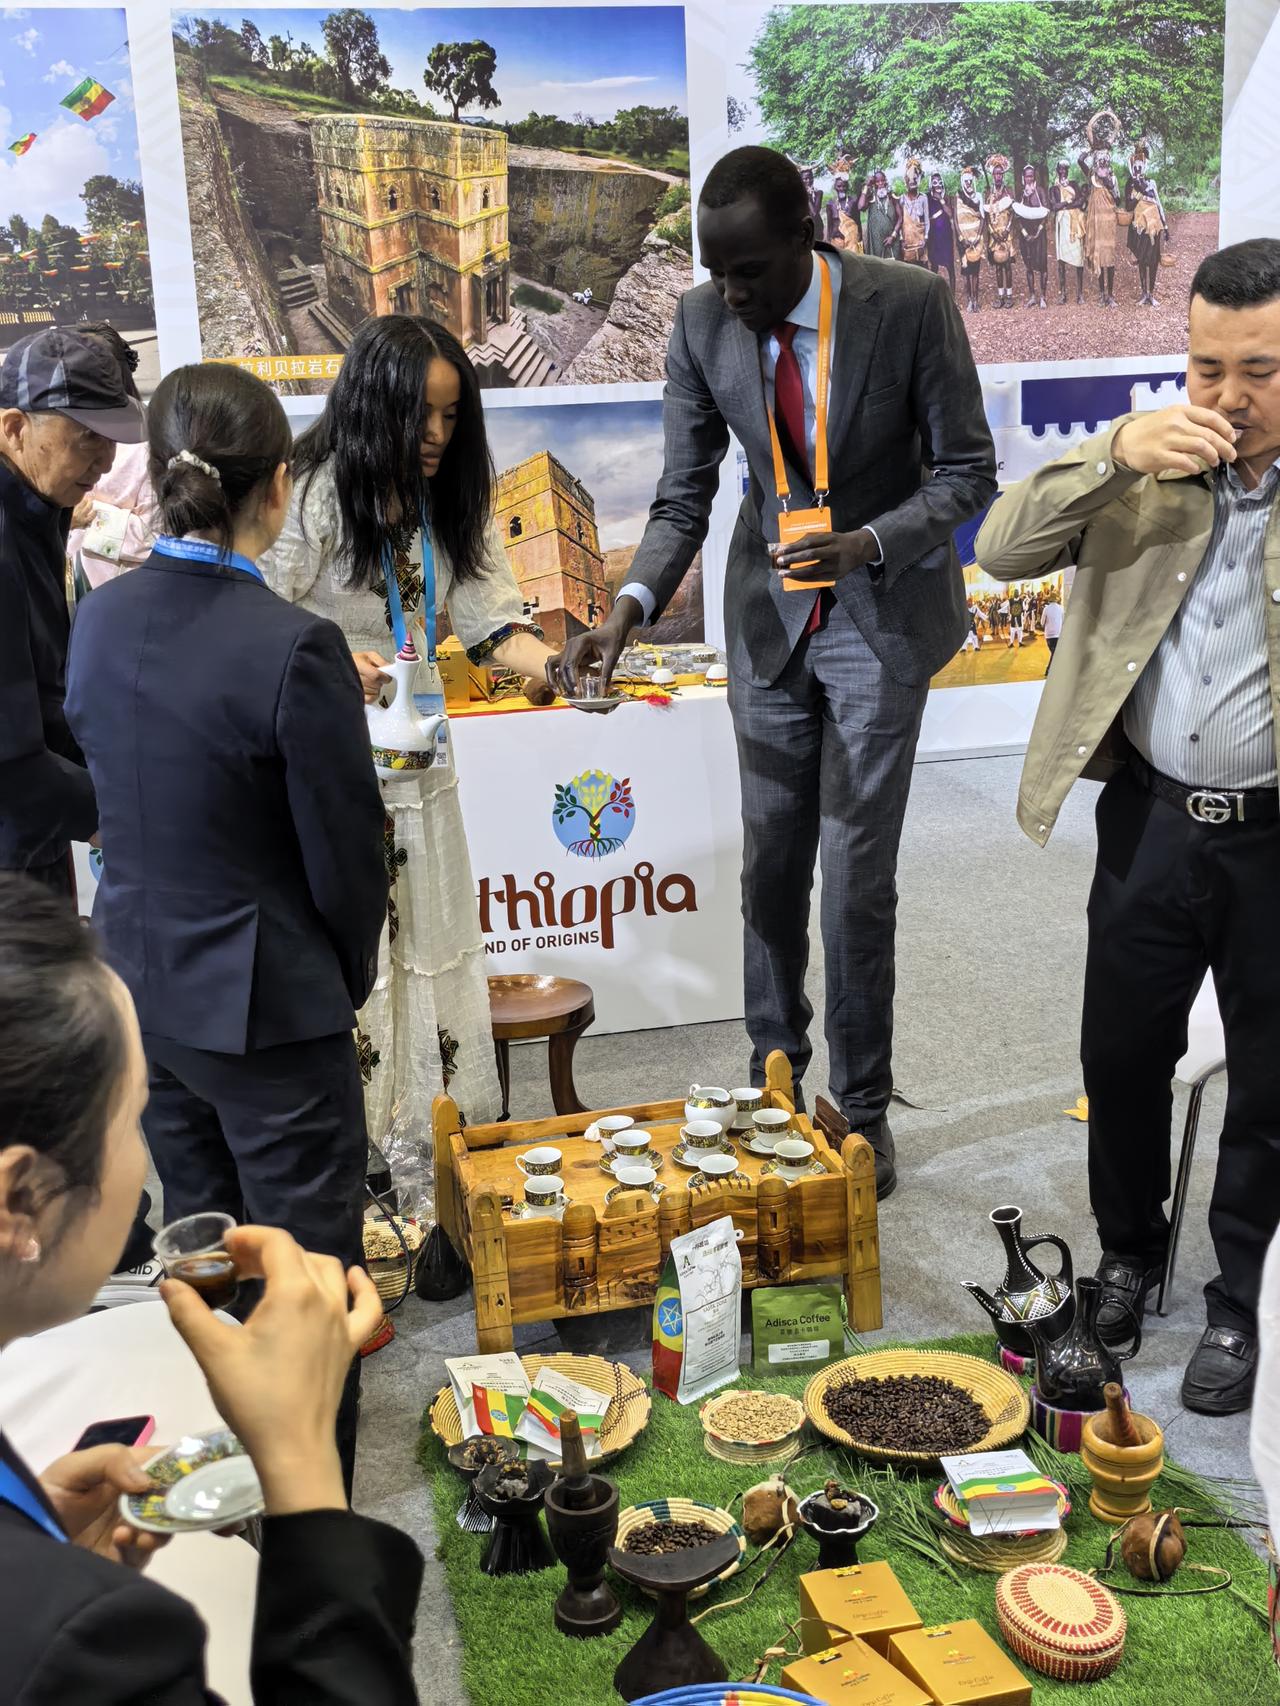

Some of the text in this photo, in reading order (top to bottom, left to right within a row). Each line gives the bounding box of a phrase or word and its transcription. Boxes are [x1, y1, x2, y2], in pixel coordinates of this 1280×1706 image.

[476, 861, 698, 949] thiopia
[484, 930, 600, 954] ND OF ORIGINS
[765, 1313, 831, 1328] Adisca Coffee
